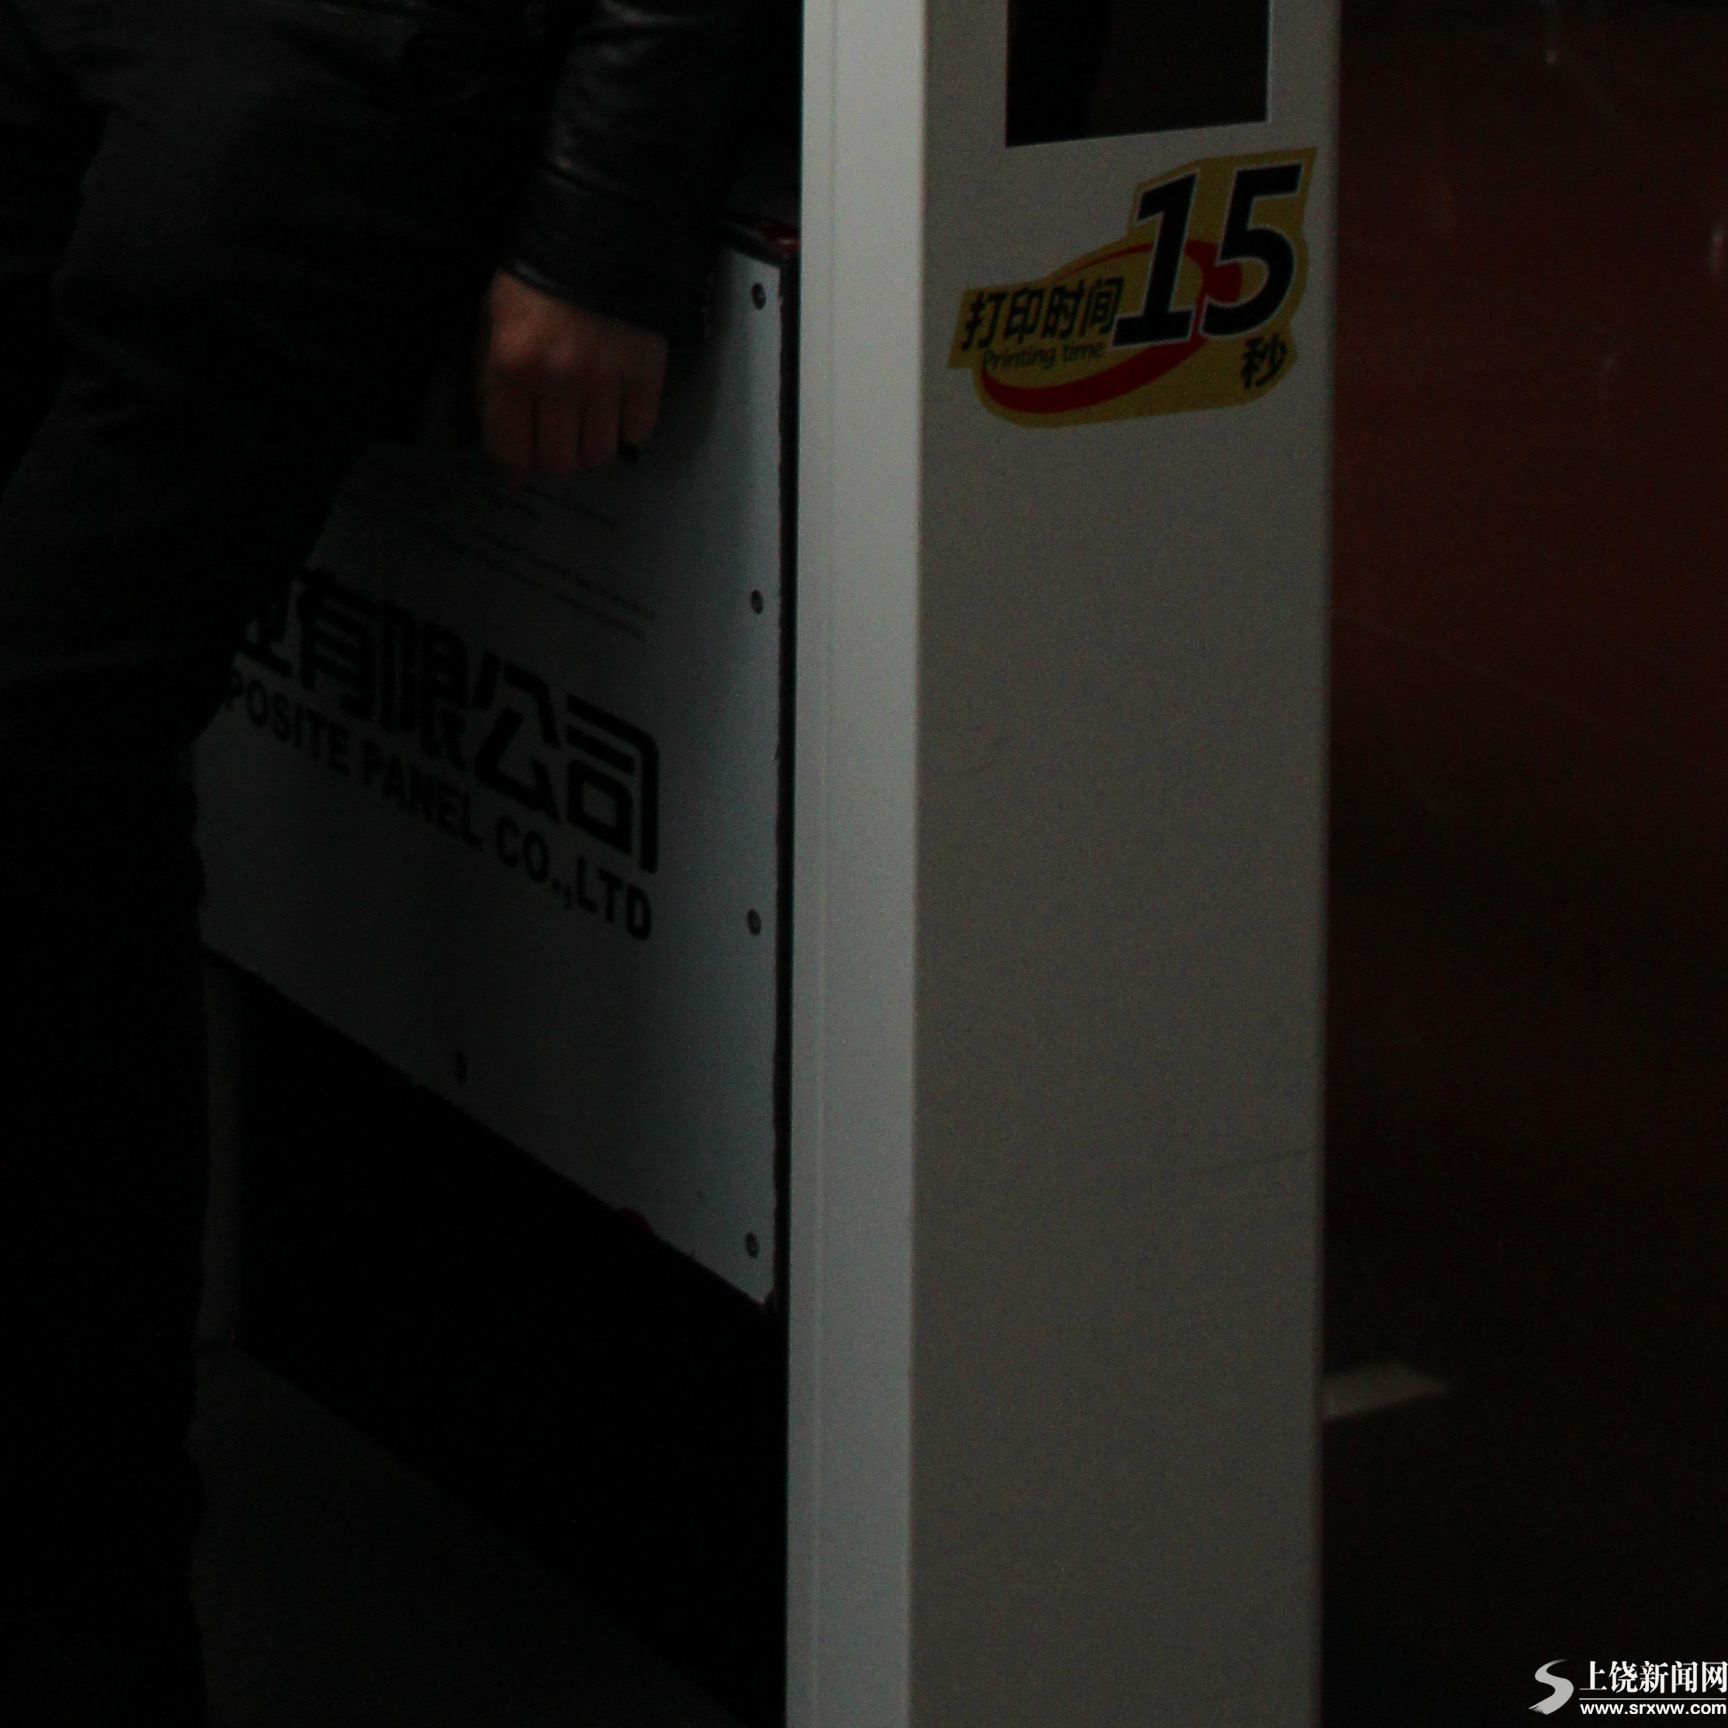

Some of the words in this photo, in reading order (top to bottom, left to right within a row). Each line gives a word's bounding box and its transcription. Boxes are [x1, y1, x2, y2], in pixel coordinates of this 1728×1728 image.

[1110, 162, 1306, 347] 15
[962, 277, 1124, 351] 打印时间
[1240, 332, 1287, 390] 秒
